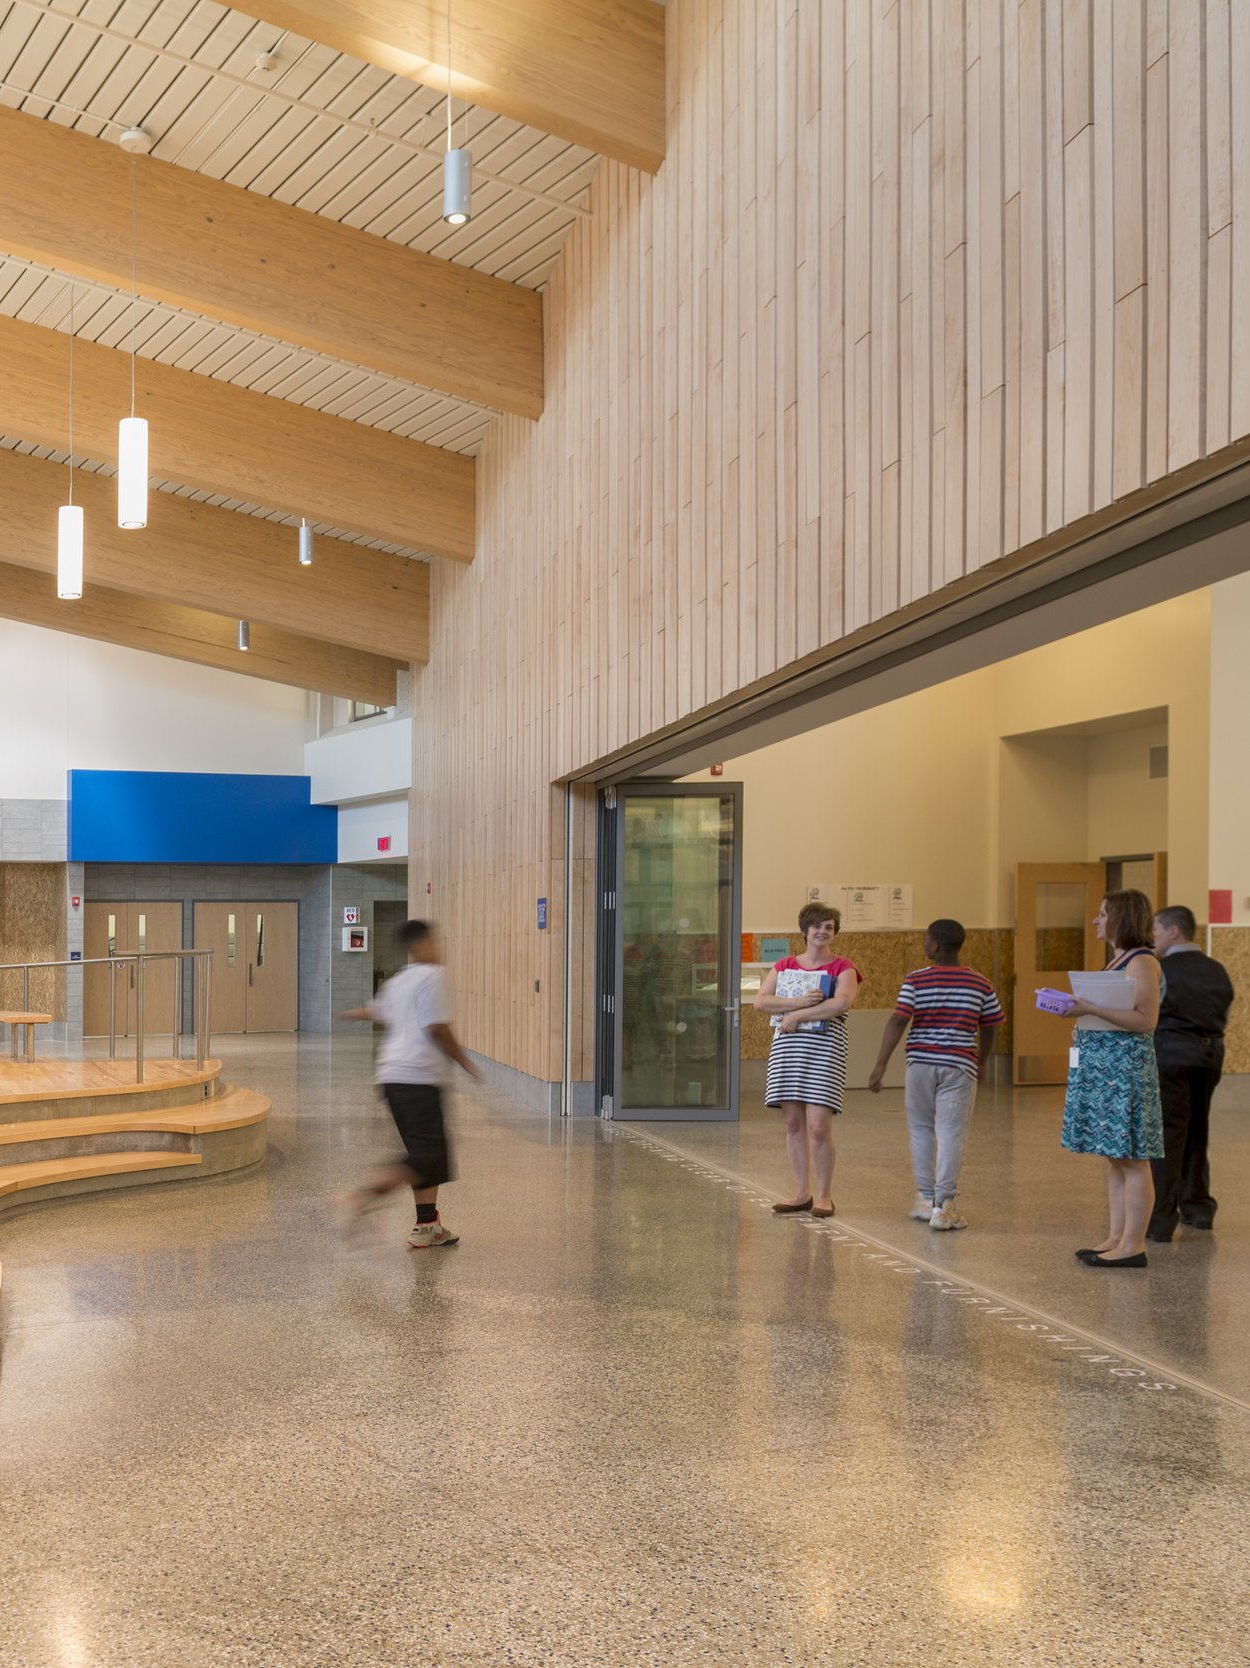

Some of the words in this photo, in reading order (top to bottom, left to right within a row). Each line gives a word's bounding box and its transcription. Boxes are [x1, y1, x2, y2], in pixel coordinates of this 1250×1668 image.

[680, 1164, 730, 1182] CLEAR
[726, 1186, 756, 1194] OF
[862, 1253, 921, 1273] AND
[922, 1280, 1177, 1391] FURNISHINGS
